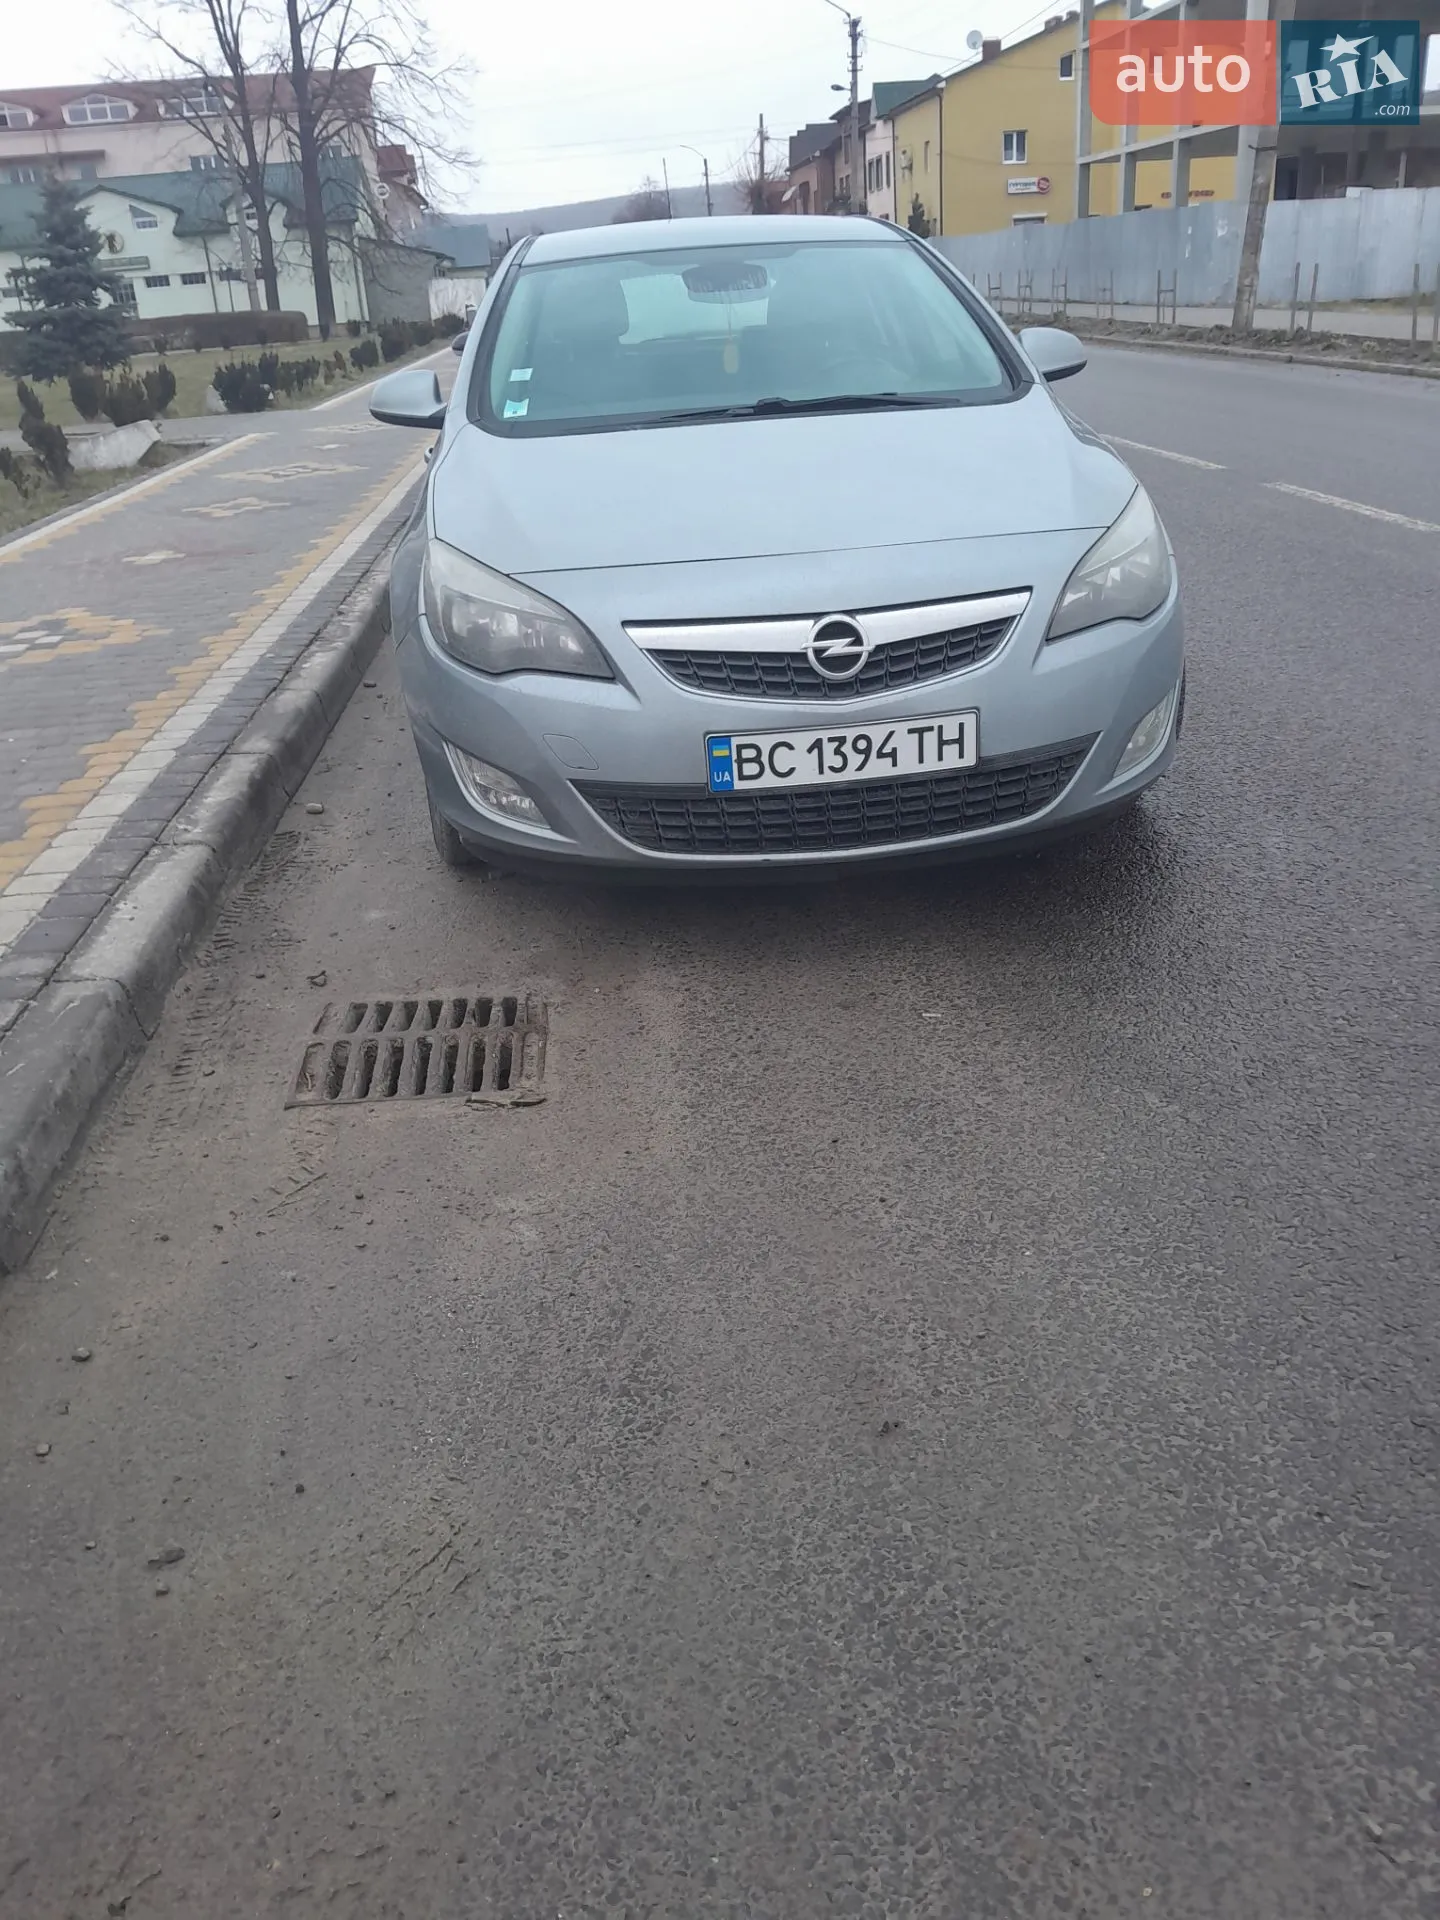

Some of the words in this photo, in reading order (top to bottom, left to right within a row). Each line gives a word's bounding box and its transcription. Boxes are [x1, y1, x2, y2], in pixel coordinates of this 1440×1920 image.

[734, 741, 797, 781] BC
[806, 729, 898, 775] 1394
[907, 722, 965, 764] TH
[713, 770, 731, 783] UA
